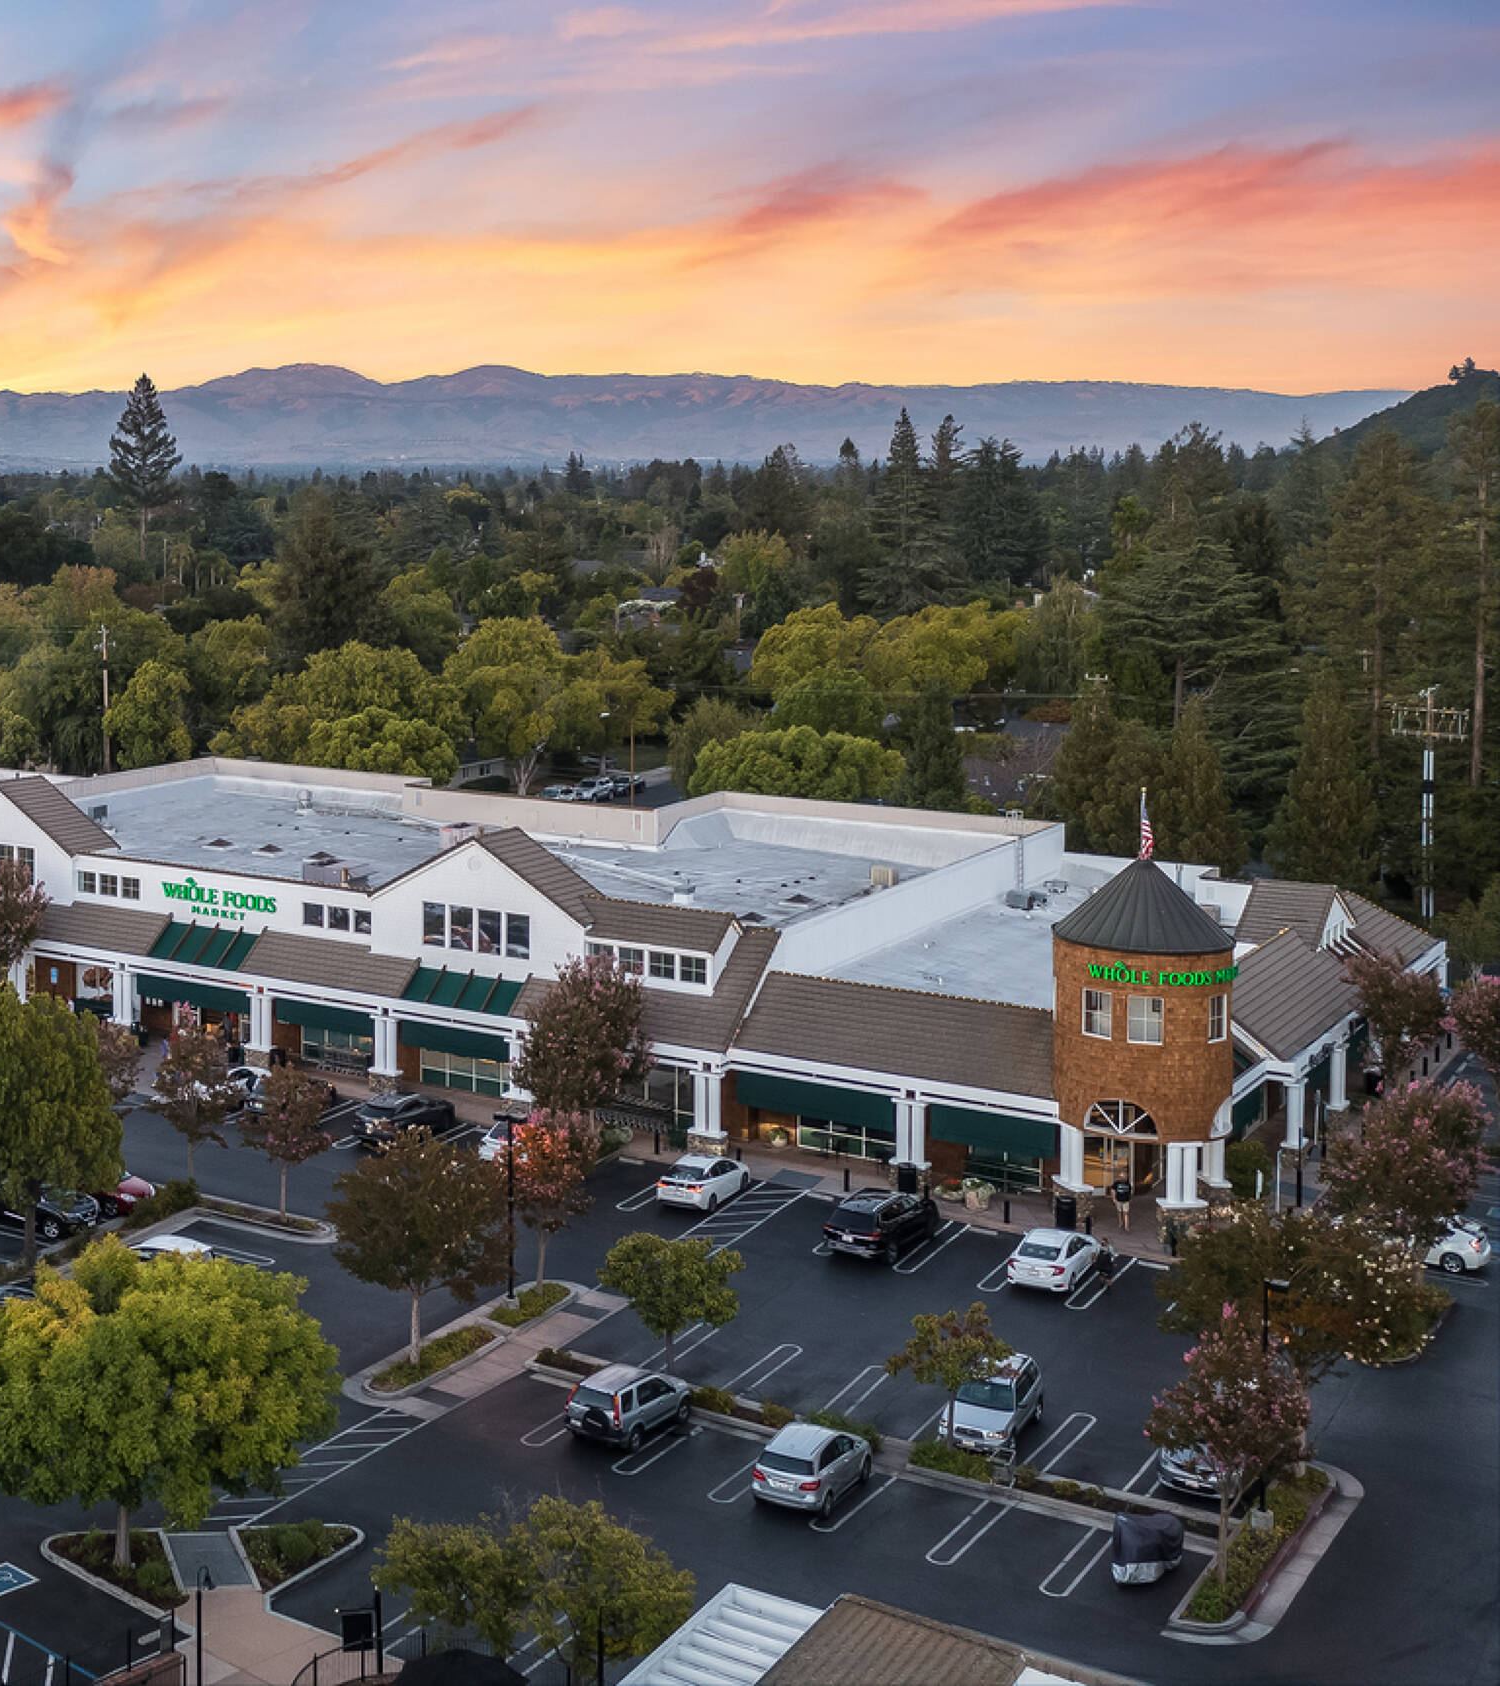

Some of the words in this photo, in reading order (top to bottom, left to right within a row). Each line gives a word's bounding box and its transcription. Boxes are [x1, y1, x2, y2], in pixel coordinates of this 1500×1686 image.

[161, 881, 219, 905] WHOLE
[222, 890, 276, 913] FOODS
[191, 905, 245, 921] MARKET
[1088, 963, 1152, 985] WHOLE
[1159, 970, 1212, 987] FOODS
